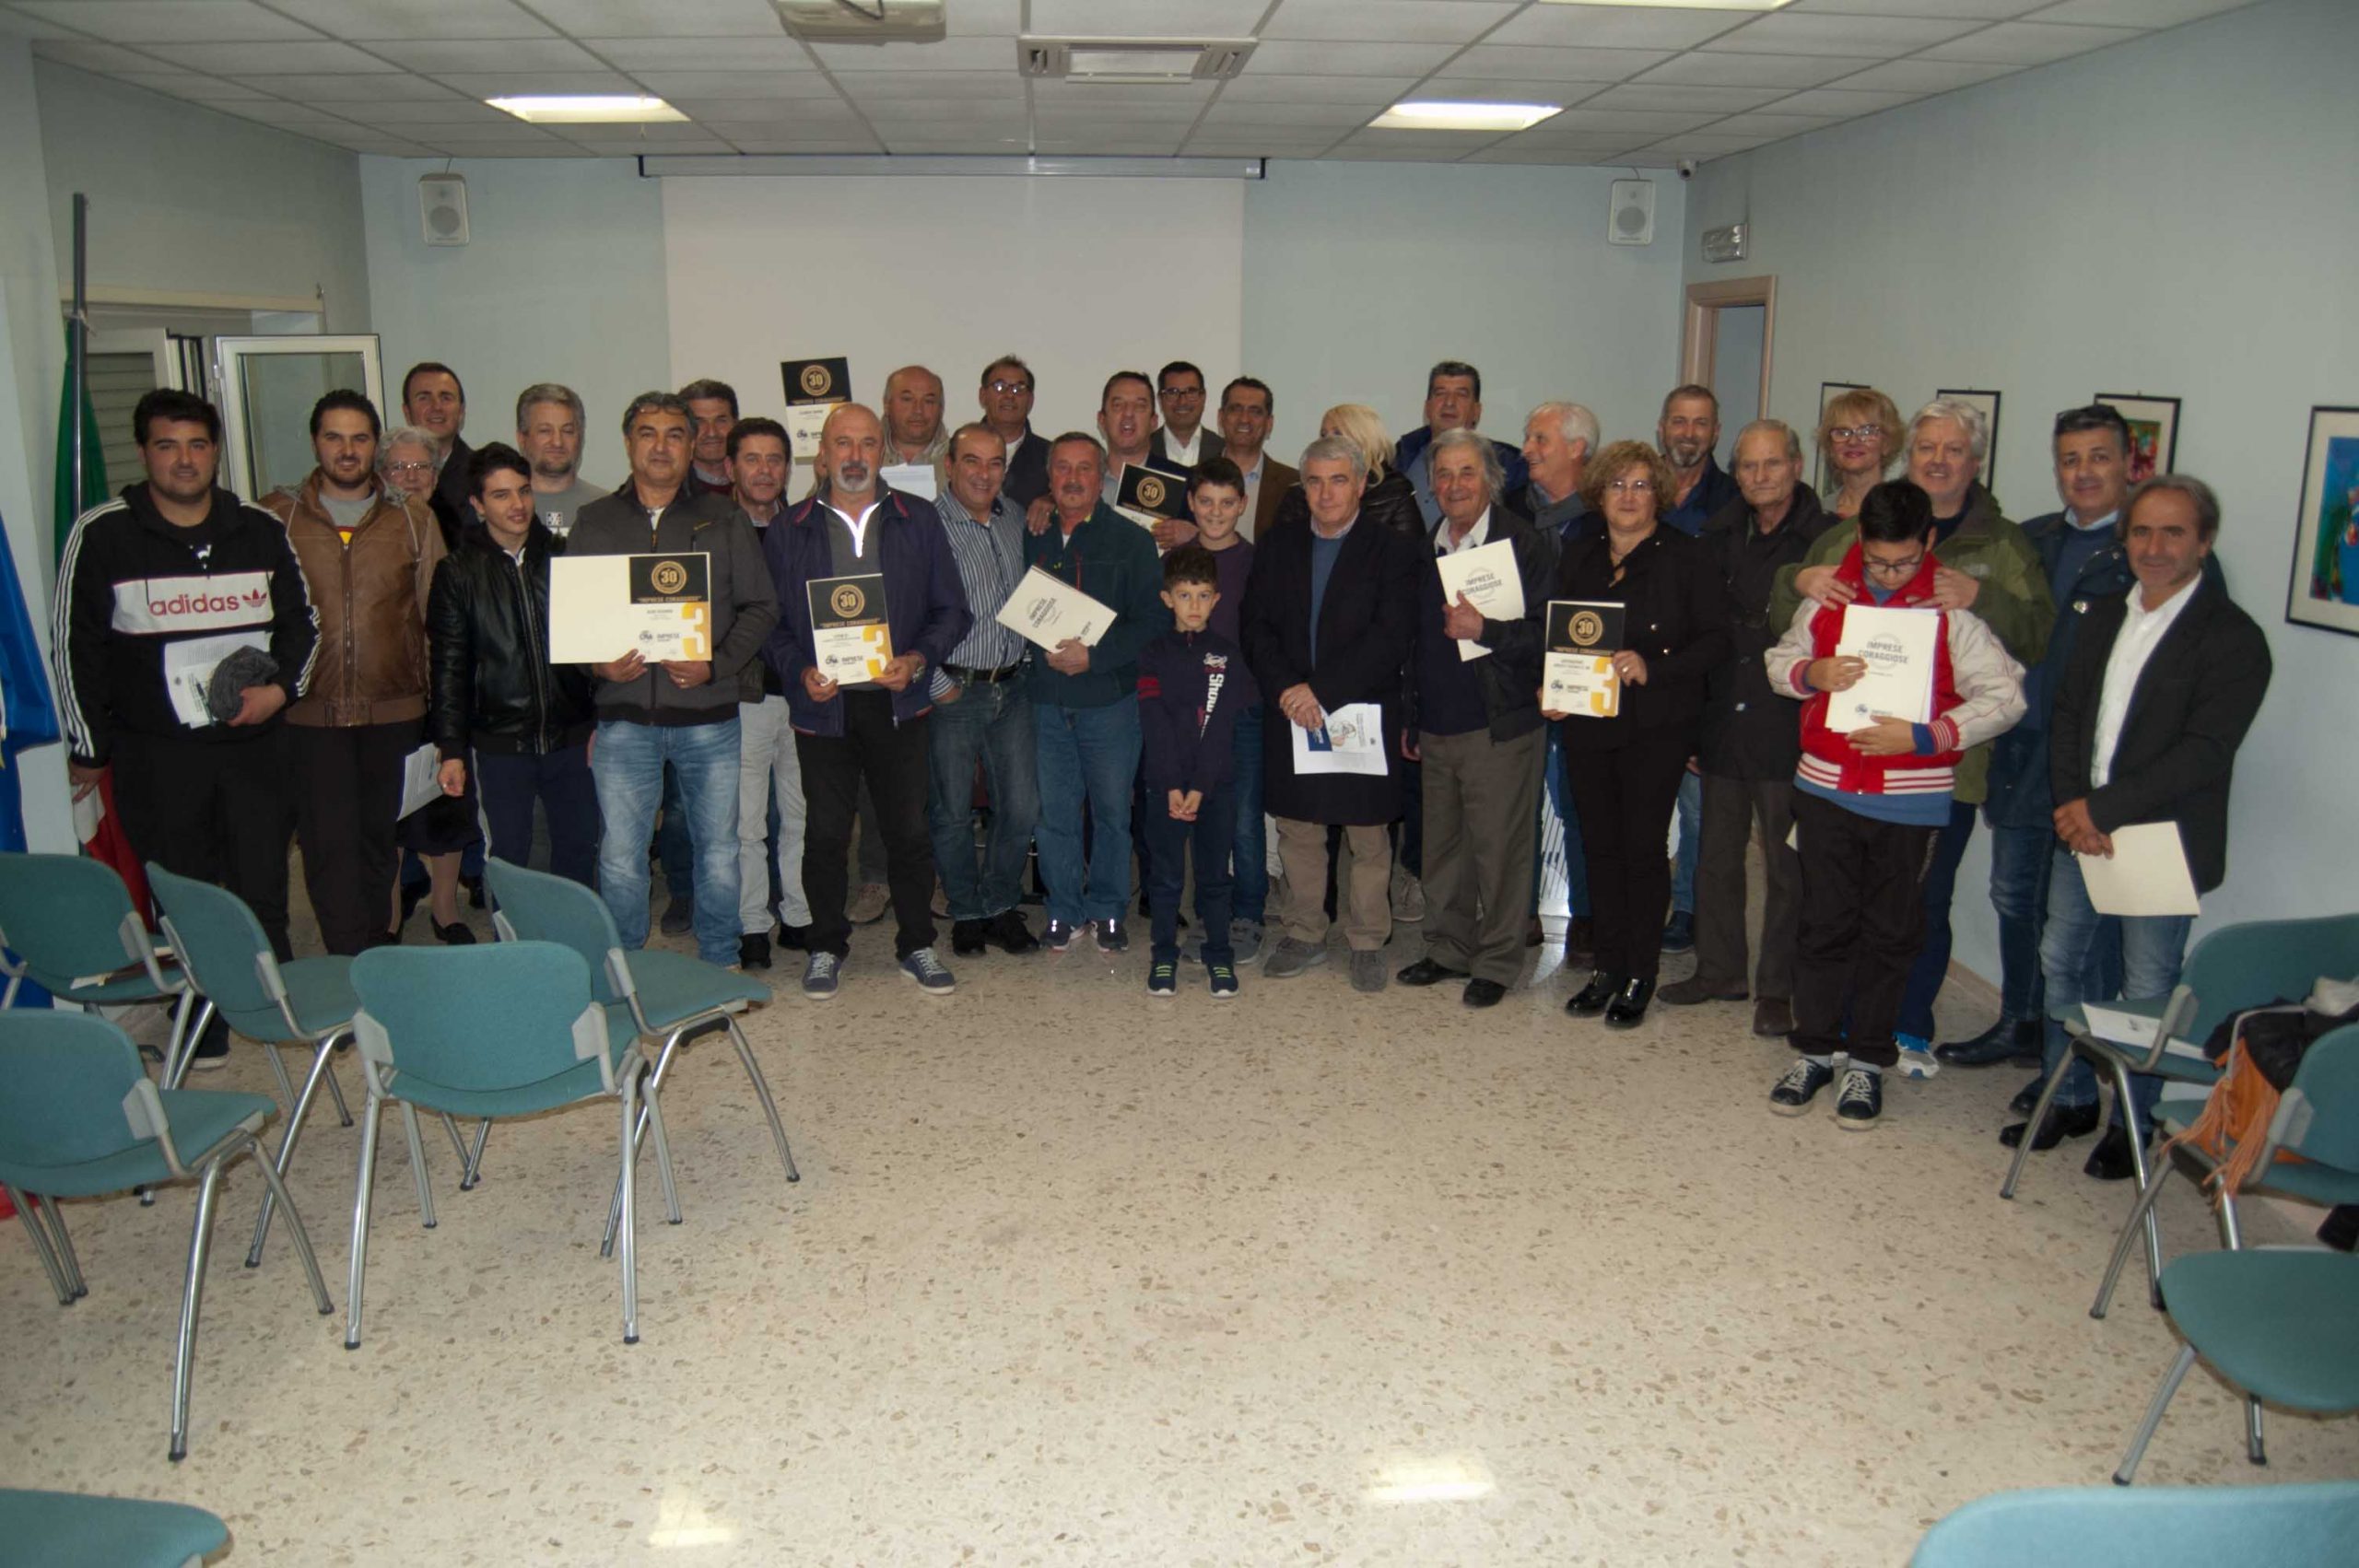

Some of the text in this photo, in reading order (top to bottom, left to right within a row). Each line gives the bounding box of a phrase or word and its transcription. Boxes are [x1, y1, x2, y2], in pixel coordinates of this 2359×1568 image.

[810, 374, 824, 386] 30
[1144, 485, 1158, 499] 30
[661, 570, 677, 583] 30
[1466, 574, 1495, 585] IMPRESE
[149, 594, 240, 616] adidas
[840, 594, 856, 607] 30
[1578, 621, 1594, 635] 30
[1868, 642, 1903, 653] IMPRESE
[1859, 650, 1909, 664] CORAGGIOSE
[1207, 673, 1224, 713] Show
